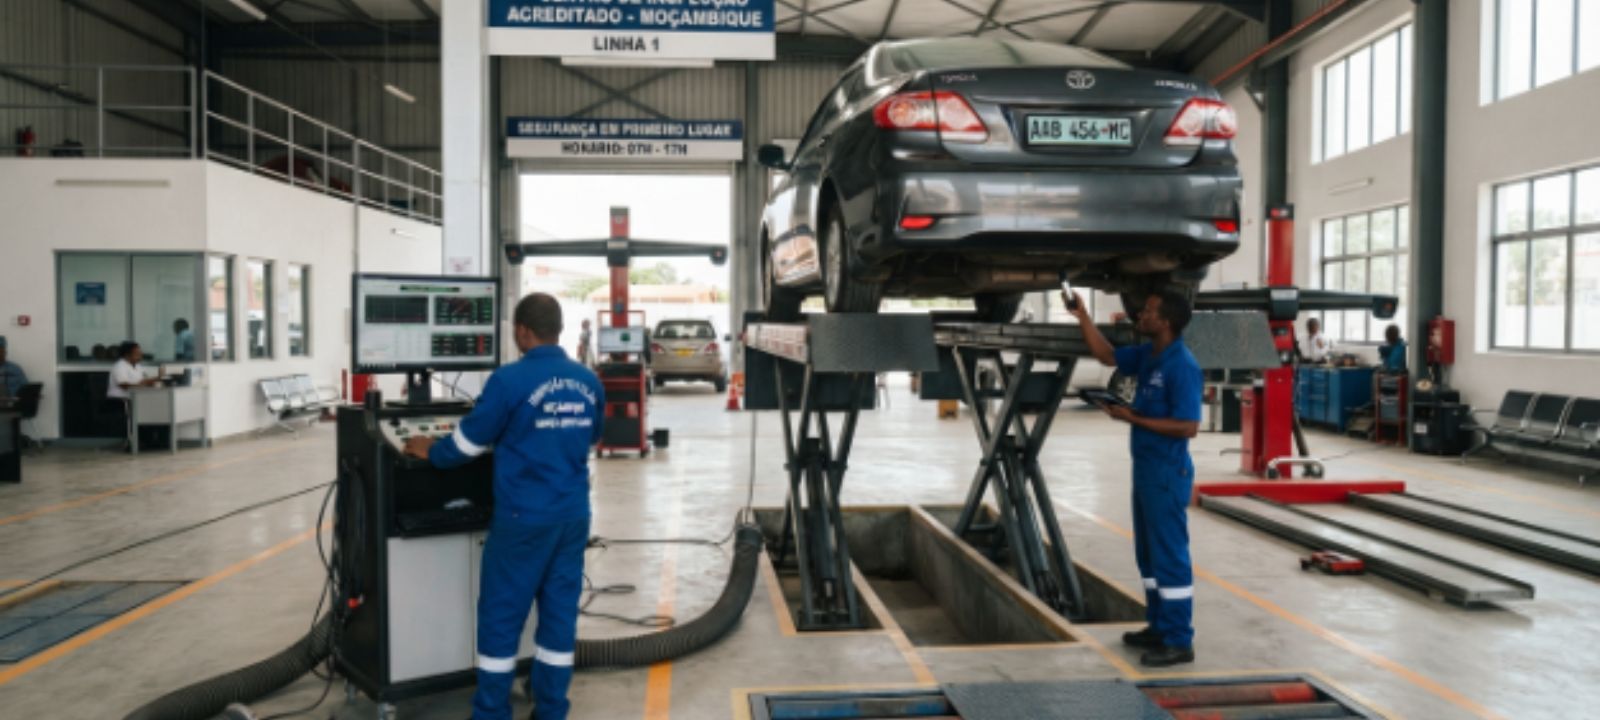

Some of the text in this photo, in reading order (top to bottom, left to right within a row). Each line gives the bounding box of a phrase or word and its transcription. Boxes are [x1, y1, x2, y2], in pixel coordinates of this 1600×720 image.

[507, 6, 622, 23] ACREDITADO
[640, 7, 763, 28] MOÇAMBIQUE
[593, 35, 660, 52] LINHA 1
[1031, 119, 1062, 140] AAB
